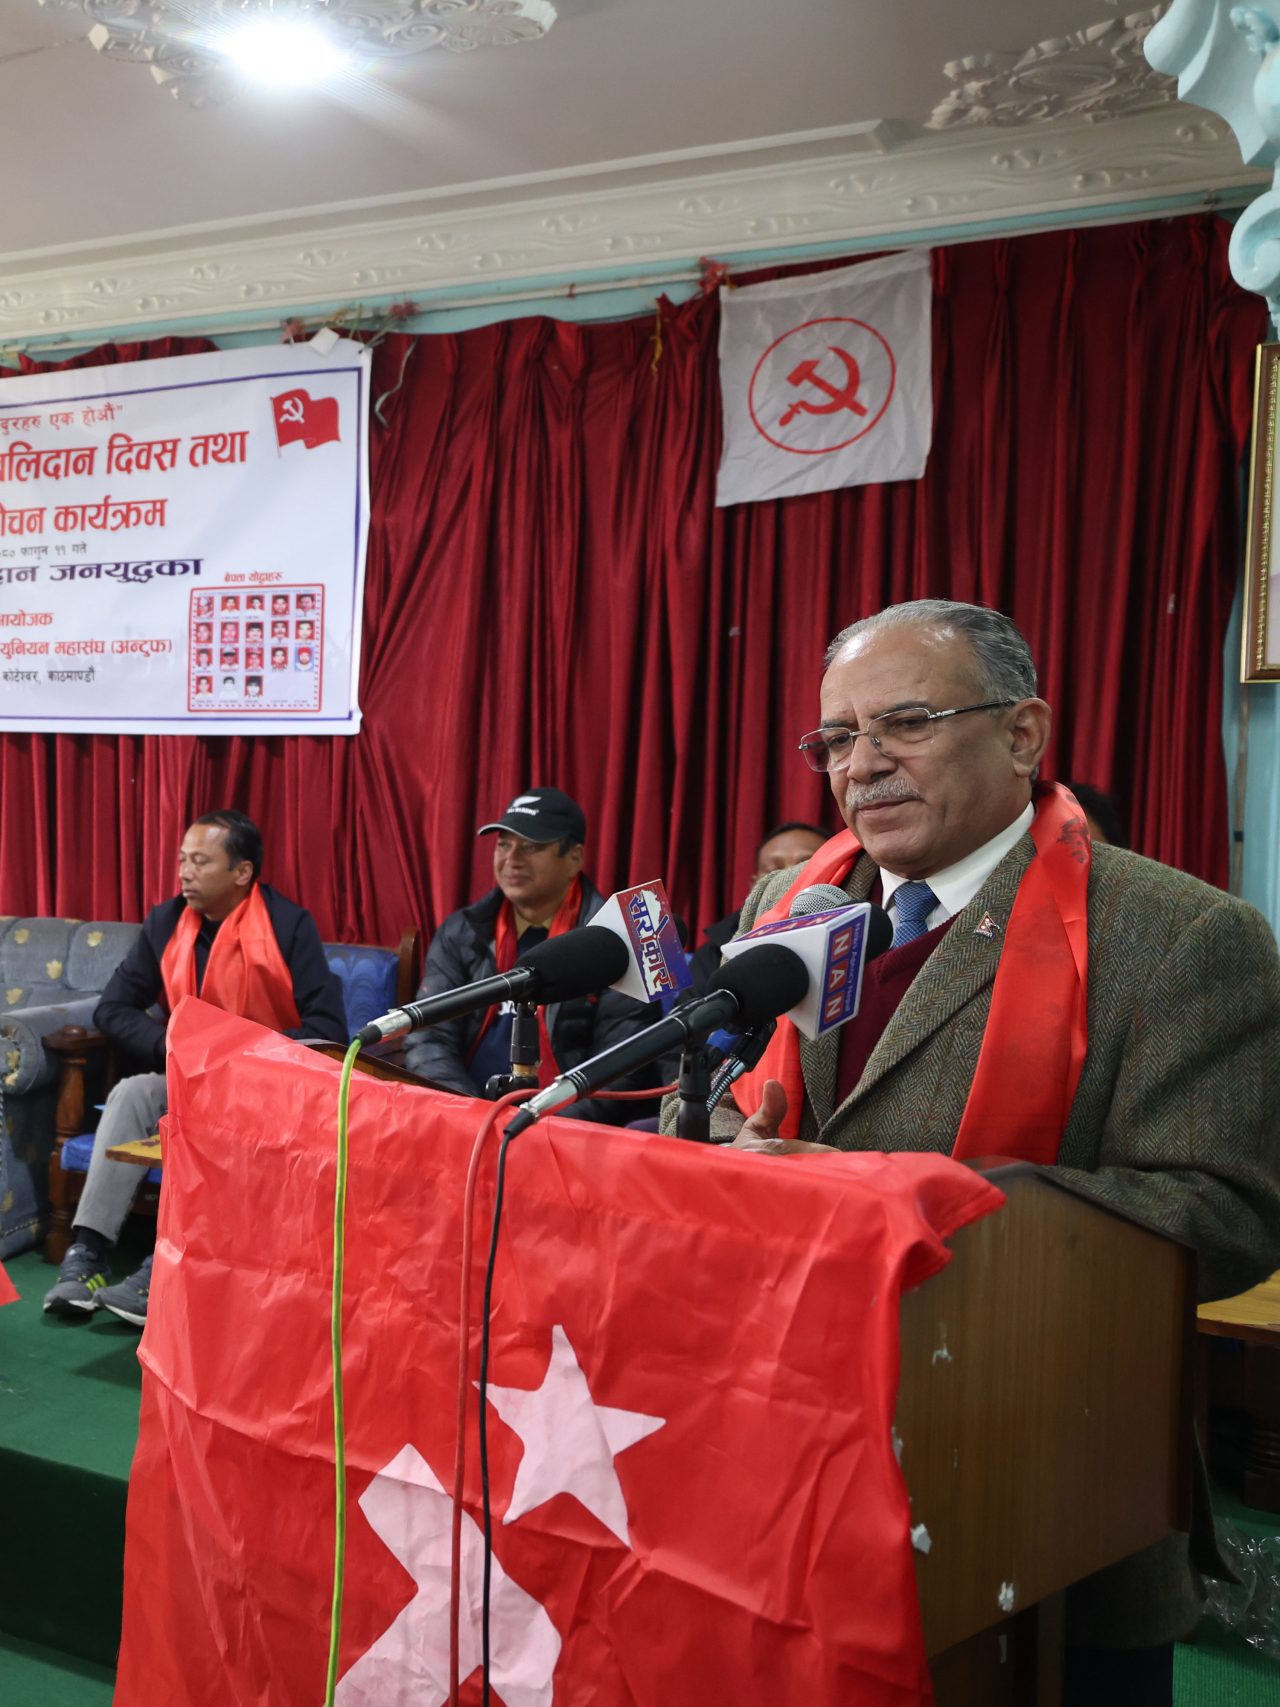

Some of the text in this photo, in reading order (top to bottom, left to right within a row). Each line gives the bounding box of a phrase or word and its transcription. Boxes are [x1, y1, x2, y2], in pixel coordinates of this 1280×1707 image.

[50, 413, 74, 430] एक
[106, 432, 181, 474] दिवस
[189, 430, 249, 468] तथा
[53, 494, 168, 532] कार्यक्रम
[49, 558, 204, 583] जनयुद्धका
[0, 638, 51, 660] युनियन
[54, 637, 106, 656] महासंघ
[825, 931, 850, 1019] NAN
